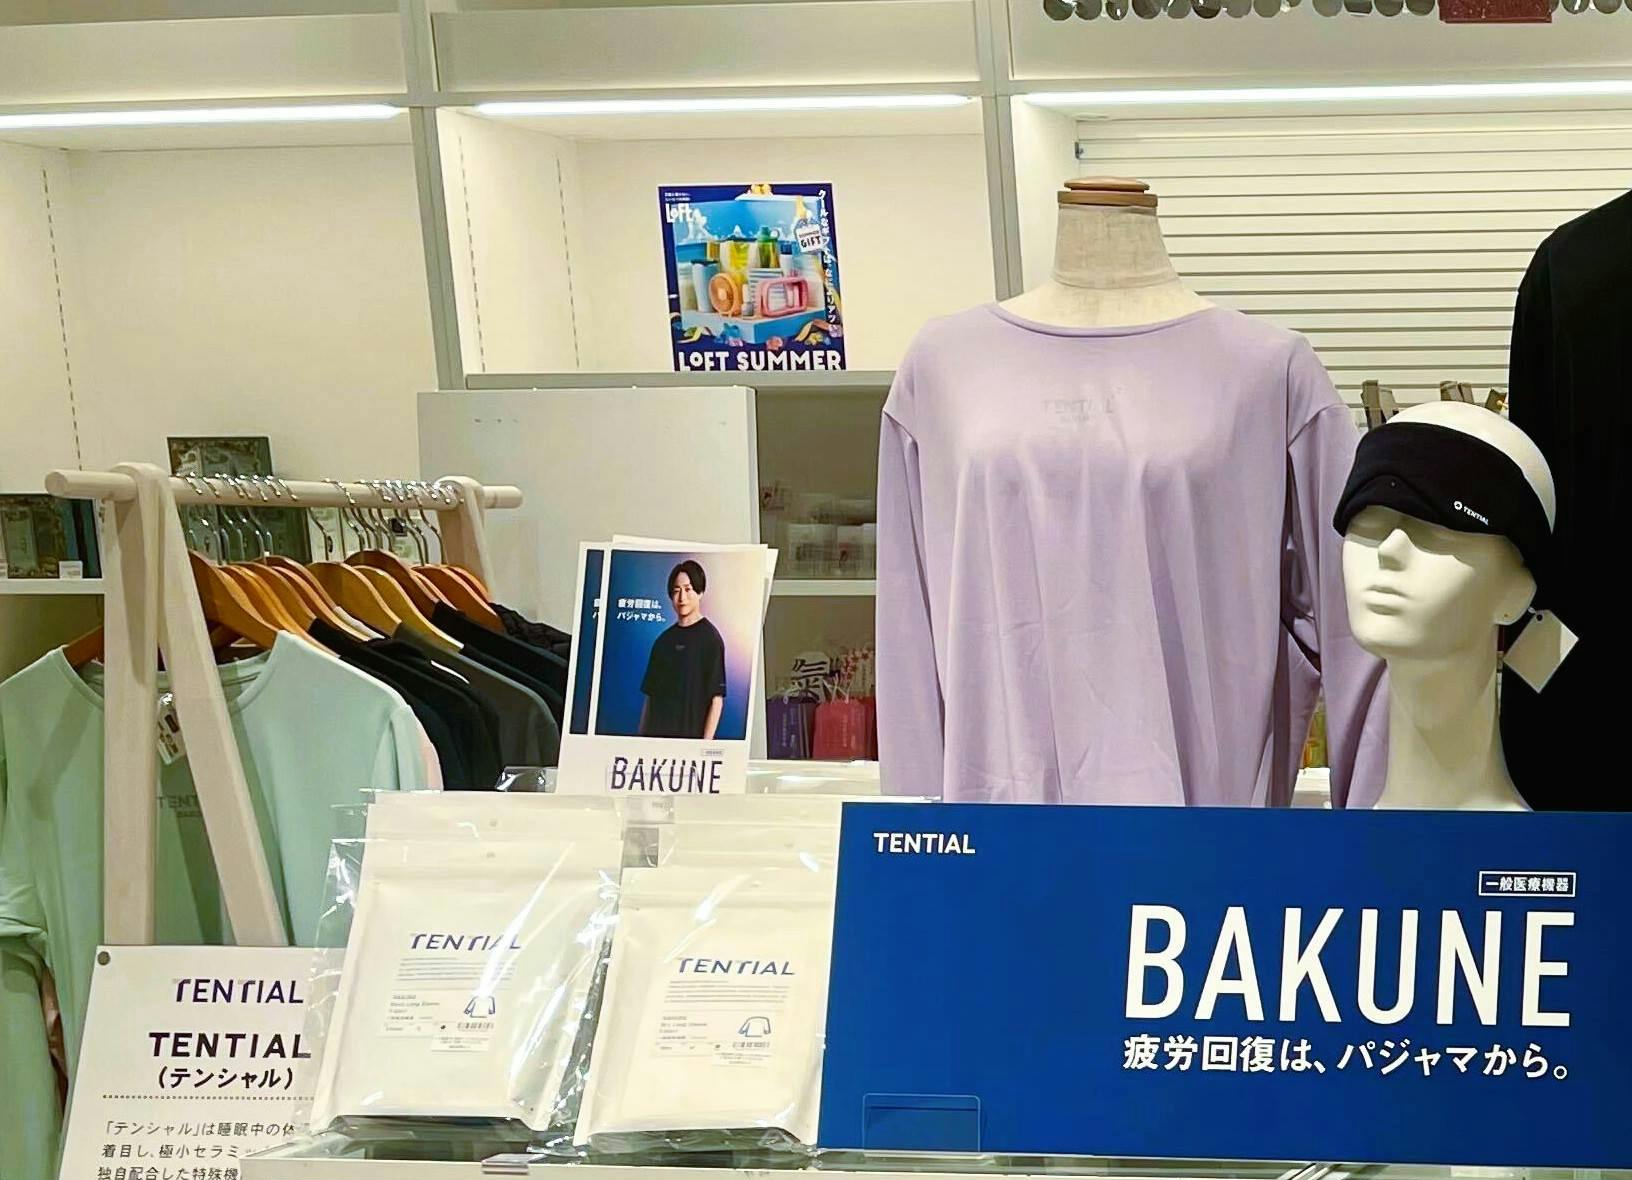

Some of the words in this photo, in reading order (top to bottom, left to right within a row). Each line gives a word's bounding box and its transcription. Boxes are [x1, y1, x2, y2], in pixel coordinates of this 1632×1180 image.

[800, 236, 821, 248] GIFT
[737, 351, 841, 371] SUMMER
[610, 756, 724, 794] BAKUNE
[872, 831, 976, 856] TENTIAL
[1485, 876, 1569, 892] 一般医療機器
[409, 932, 521, 952] TENTIAL
[678, 957, 796, 977] TENTIAL
[1124, 904, 1574, 1028] BAKUNE
[173, 978, 304, 1004] TENTIAL
[149, 1032, 311, 1059] TENTIAL
[1123, 1034, 1570, 1080] 疲労回復は、パジャマから。
[158, 1066, 293, 1089] (テンシャル)
[105, 1121, 310, 1138] 「テンシャル」は睡眠中の体
[101, 1143, 252, 1159] 着目し、極小セラミ
